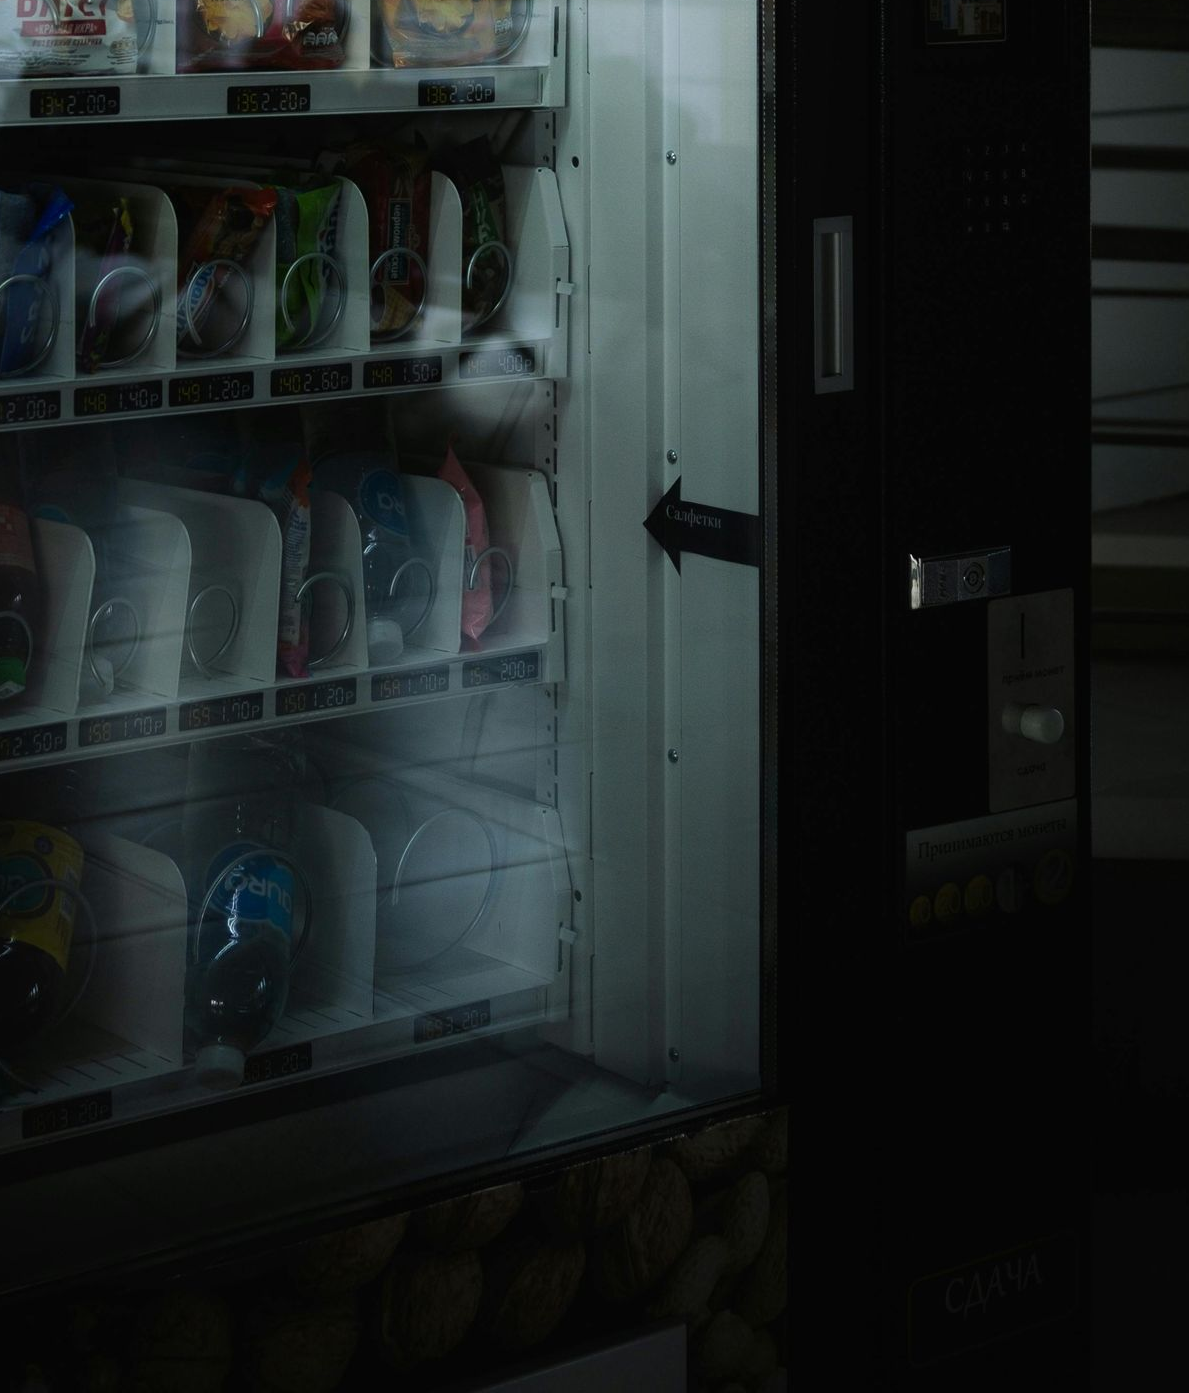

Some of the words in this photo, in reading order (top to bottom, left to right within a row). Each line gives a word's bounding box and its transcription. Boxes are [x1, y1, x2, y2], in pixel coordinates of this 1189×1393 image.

[666, 504, 722, 530] Салфетки
[917, 828, 1015, 862] Принимаются
[1017, 817, 1068, 840] монеты
[944, 1250, 1043, 1321] СДАЧА
